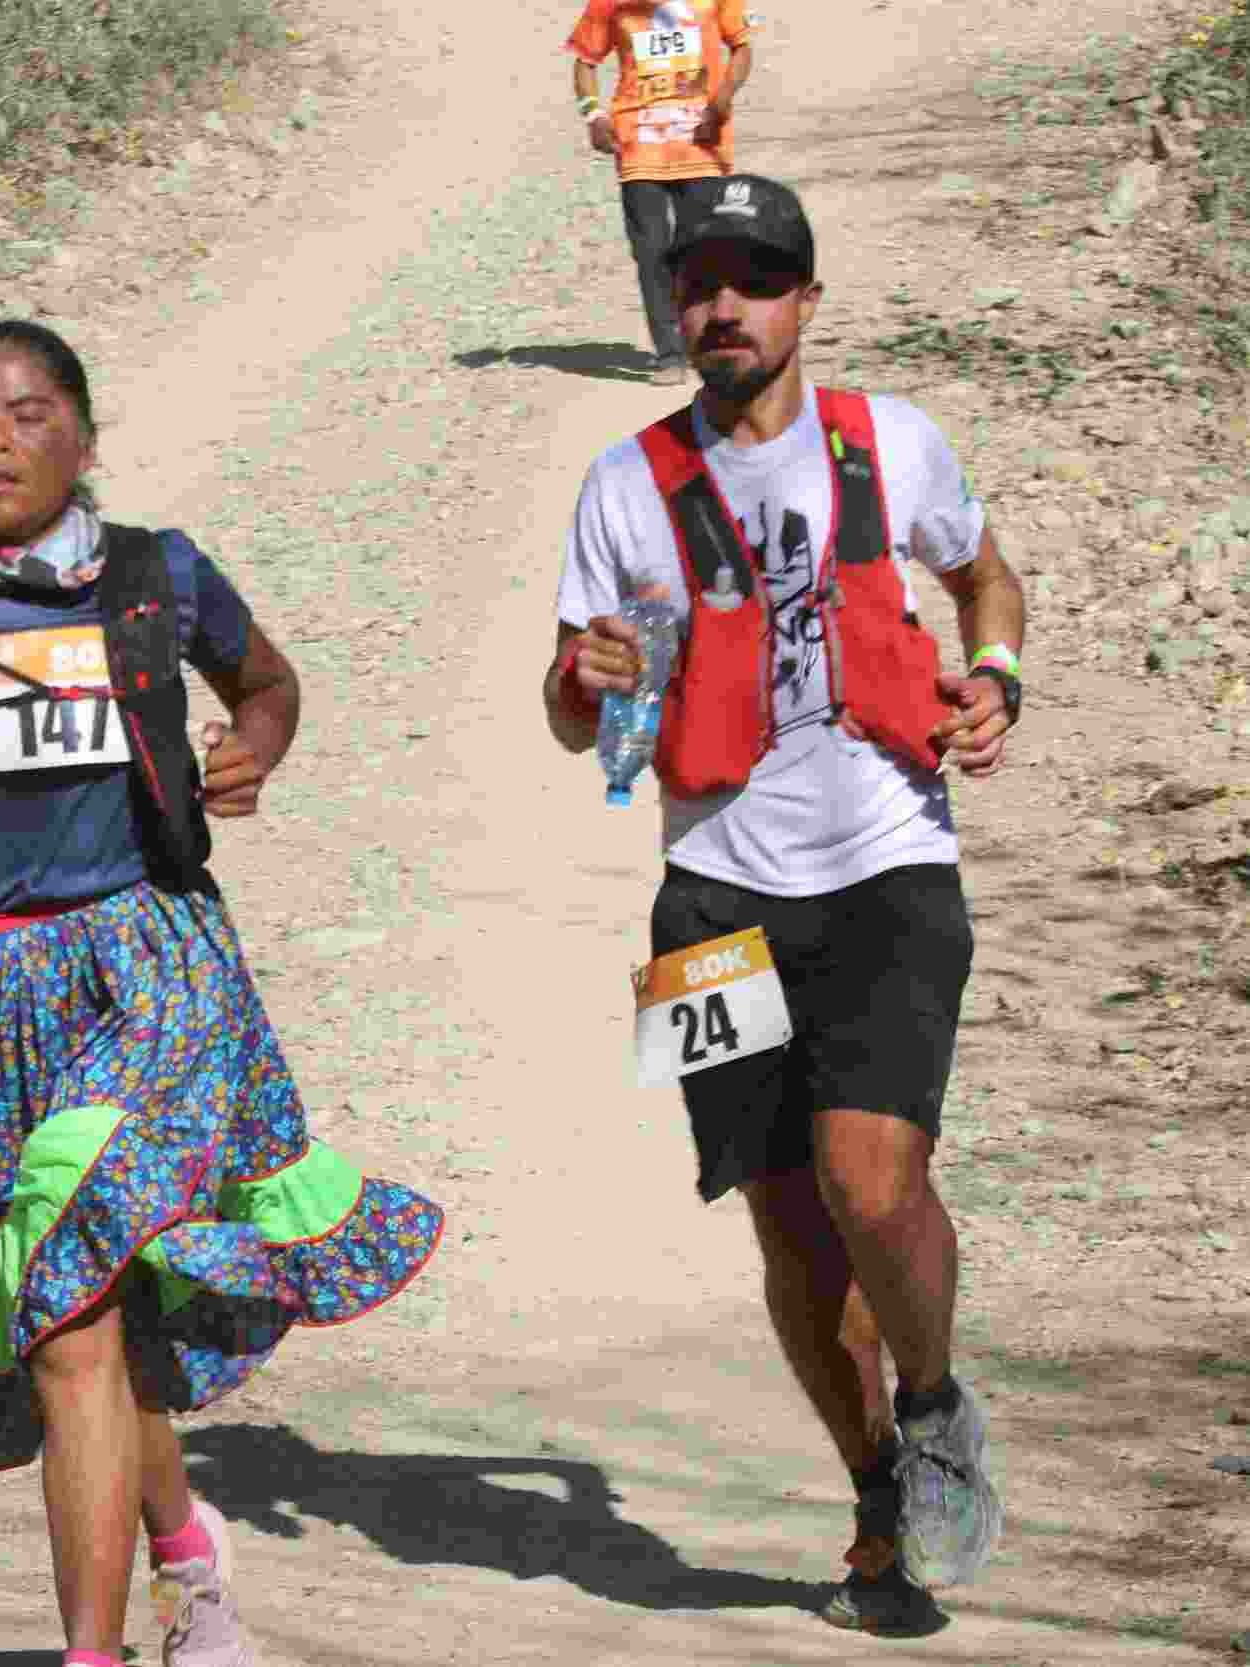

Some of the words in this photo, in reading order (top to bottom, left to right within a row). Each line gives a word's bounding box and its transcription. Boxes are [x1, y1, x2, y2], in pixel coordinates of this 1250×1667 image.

[49, 639, 108, 673] 80
[6, 690, 111, 757] 147
[686, 944, 749, 985] 80K
[670, 992, 740, 1064] 24
